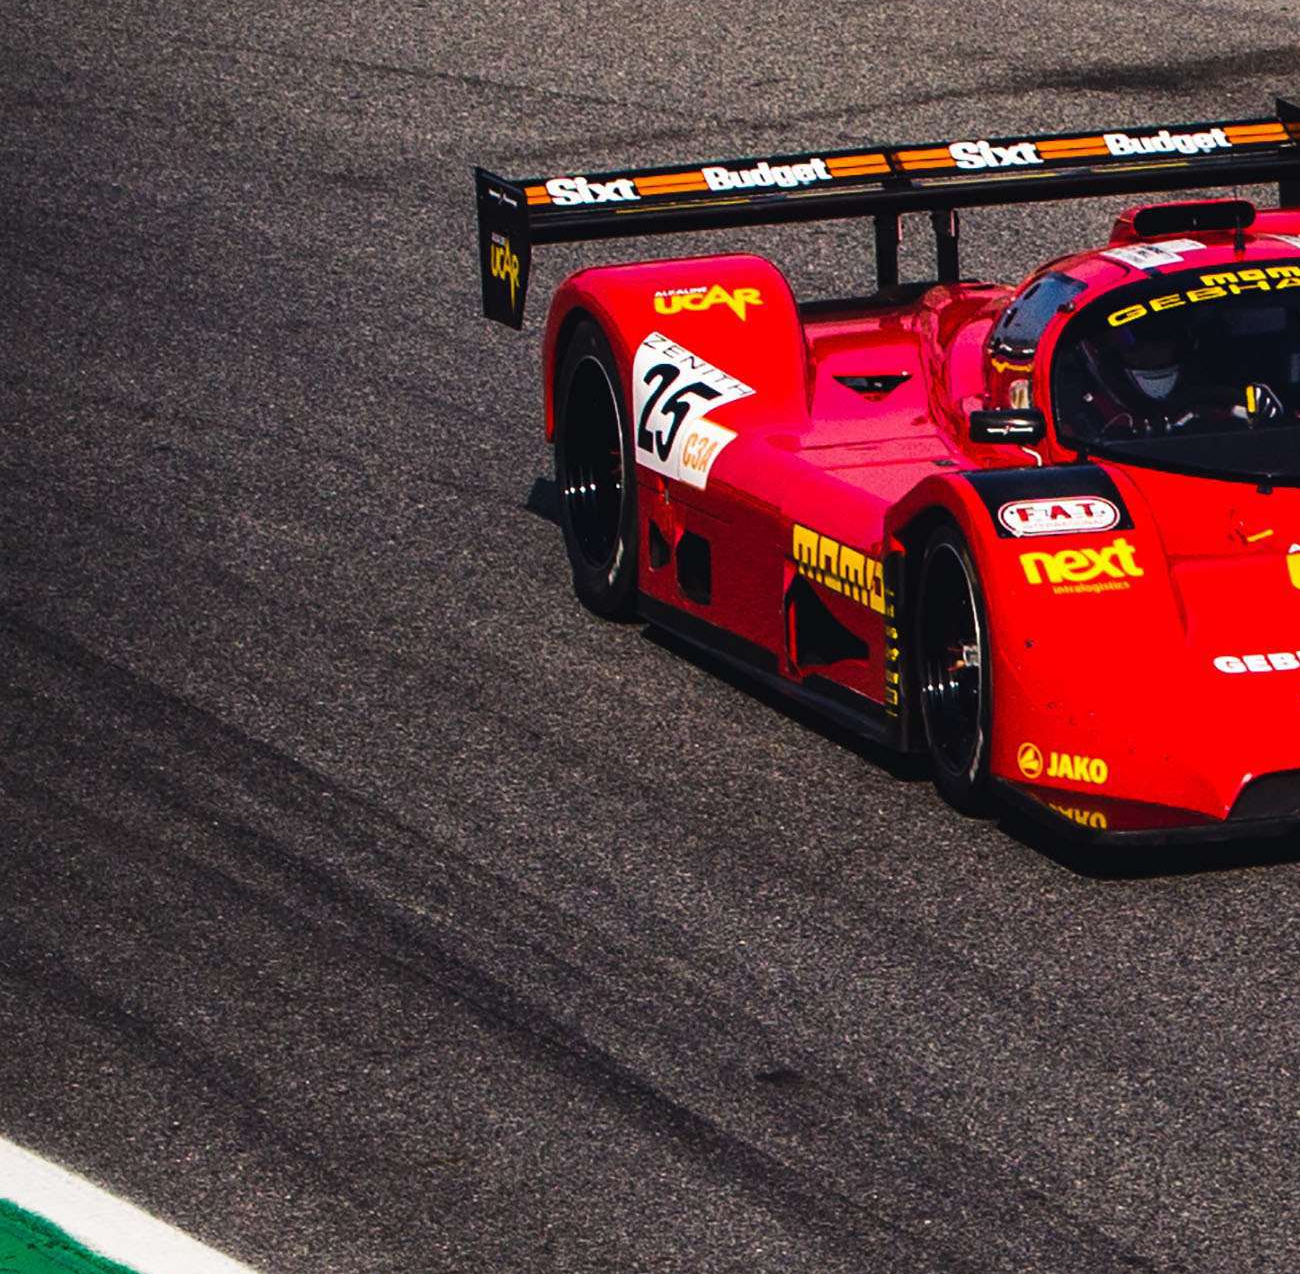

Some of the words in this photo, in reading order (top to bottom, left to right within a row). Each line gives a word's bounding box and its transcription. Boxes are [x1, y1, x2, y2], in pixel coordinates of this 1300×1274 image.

[545, 176, 641, 206] Sixt
[701, 158, 832, 192] Budget
[949, 140, 1044, 169] Sixt
[1103, 129, 1232, 156] Budget
[653, 284, 763, 322] UCAR
[643, 333, 753, 396] ZENITH
[637, 363, 723, 462] 25
[1019, 538, 1144, 584] next
[1047, 752, 1109, 785] JAKO
